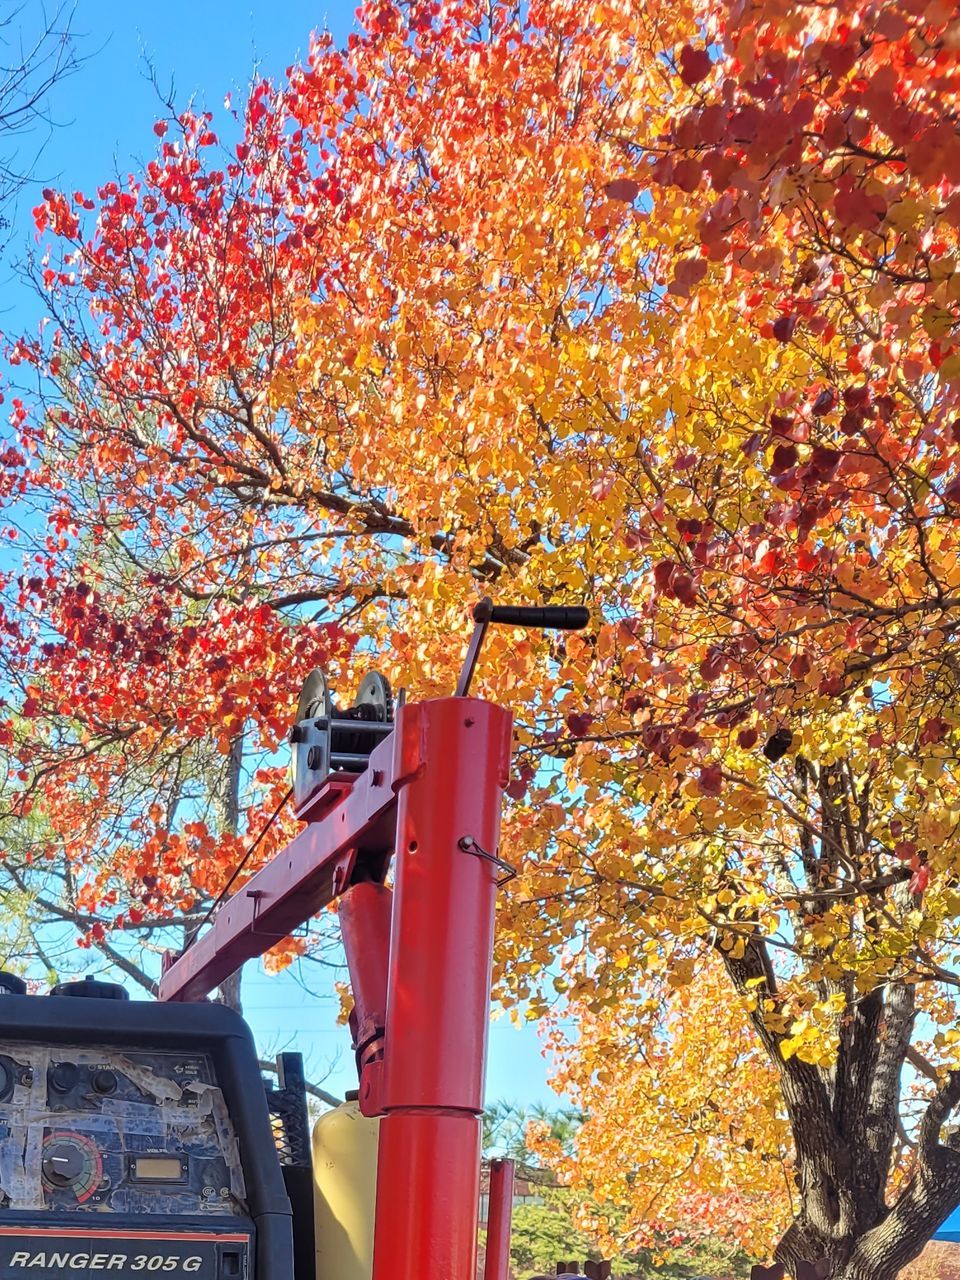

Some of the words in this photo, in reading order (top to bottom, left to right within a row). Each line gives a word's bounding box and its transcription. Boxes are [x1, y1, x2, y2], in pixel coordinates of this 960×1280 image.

[9, 1251, 128, 1270] RANGER
[130, 1254, 180, 1271] 305
[182, 1255, 203, 1272] G
